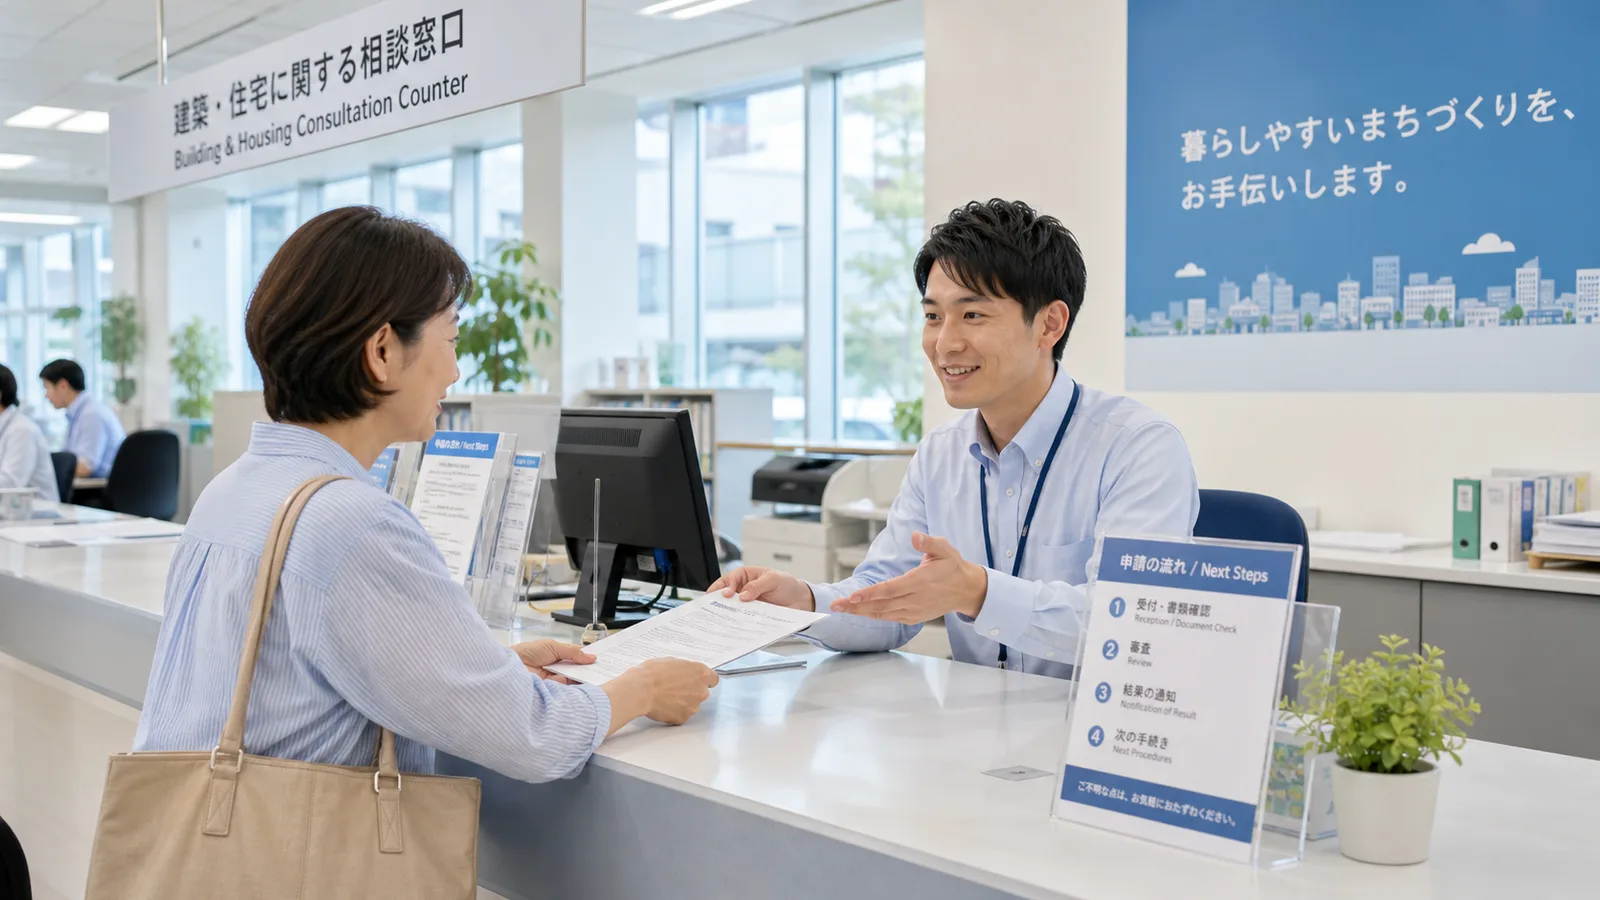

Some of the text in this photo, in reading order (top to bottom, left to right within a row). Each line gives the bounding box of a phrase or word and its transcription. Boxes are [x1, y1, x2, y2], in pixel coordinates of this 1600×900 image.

[174, 9, 463, 137] 建築・住宅に関する相談窓口
[225, 135, 234, 156] &
[238, 120, 292, 154] Housing
[296, 95, 393, 137] Consultation
[399, 73, 468, 109] Counter
[1181, 88, 1575, 163] 暮らしやすいまちづくりを、
[1181, 160, 1407, 210] お手伝いします。
[1120, 553, 1269, 585] 申請の流れ / Next Steps
[1136, 598, 1212, 618] 受付・書類確認
[1134, 614, 1170, 627] Reception
[1176, 618, 1213, 632] Document
[1214, 623, 1237, 634] Check
[1129, 640, 1151, 656] 審査
[1127, 656, 1153, 668] Review
[1122, 682, 1177, 703] 結果の通知
[1120, 699, 1197, 720] Notification of Result
[1114, 728, 1169, 750] 次の手続き
[1112, 744, 1173, 765] Next Procedures
